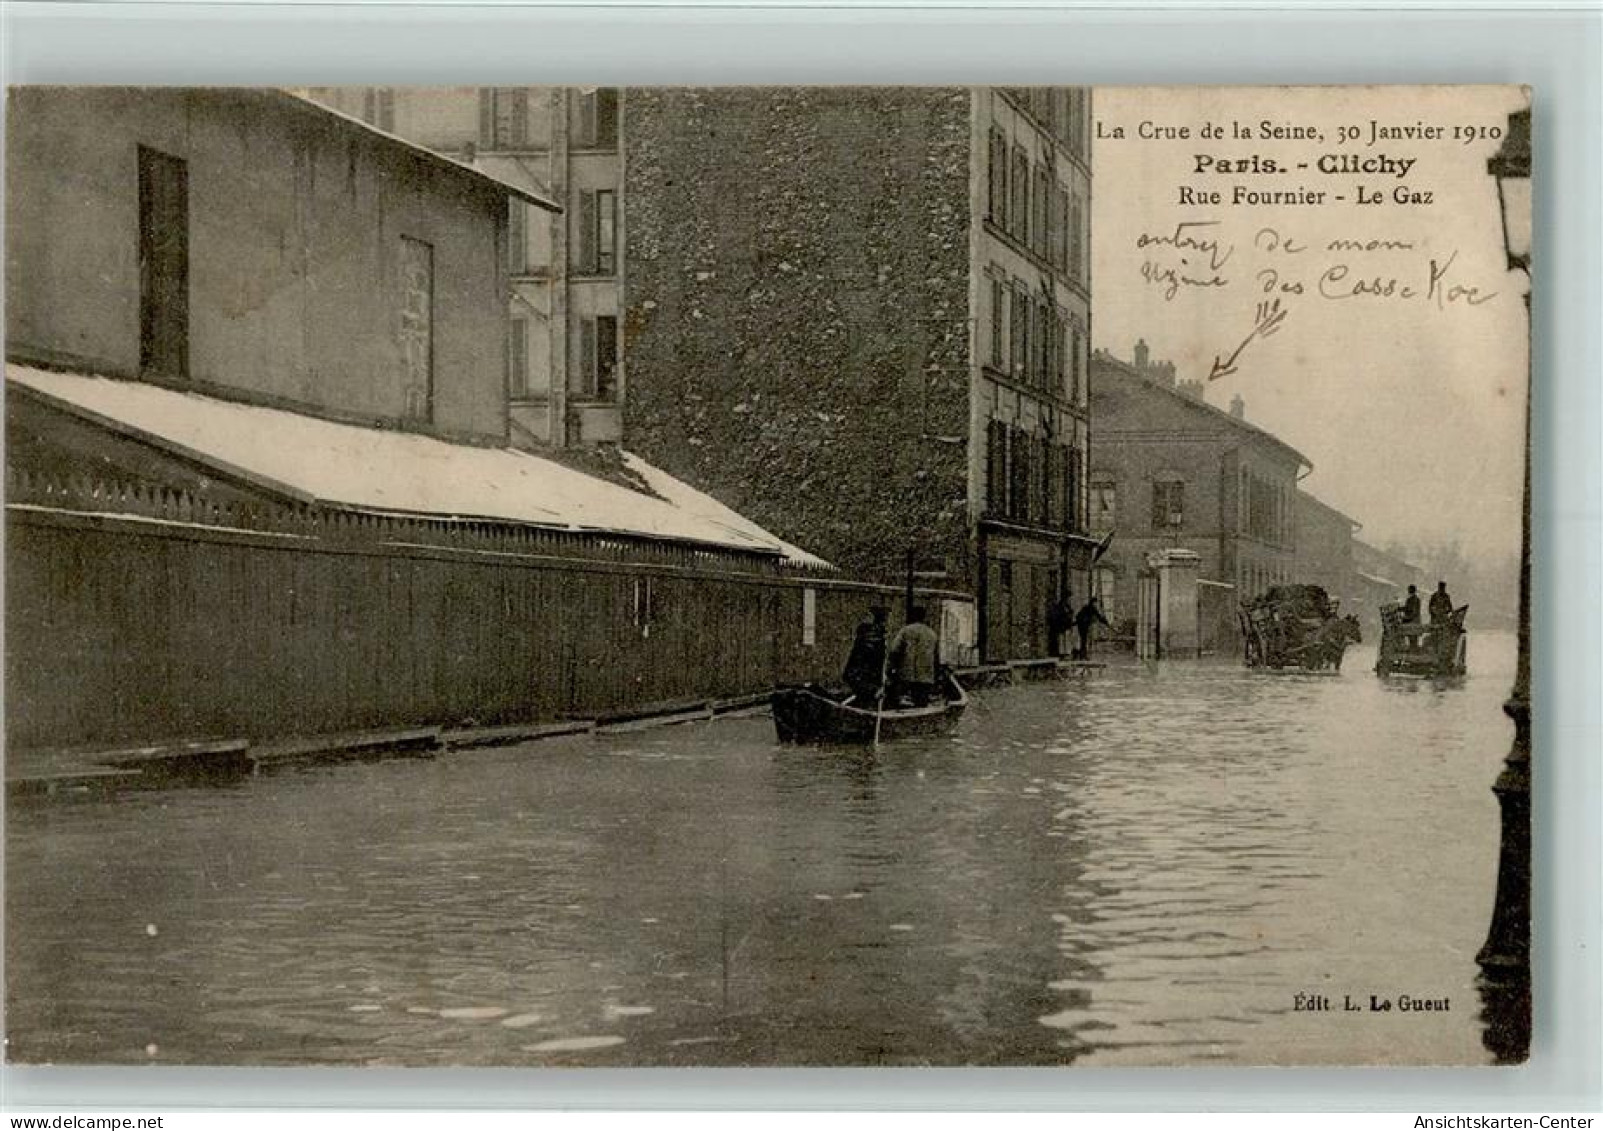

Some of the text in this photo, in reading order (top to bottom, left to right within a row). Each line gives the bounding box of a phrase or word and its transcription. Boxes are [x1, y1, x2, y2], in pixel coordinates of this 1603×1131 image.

[1097, 120, 1501, 146] La Crue de la Seine, 30 Janvier 1910
[1193, 155, 1287, 175] Paris.
[1318, 155, 1417, 178] Clichy
[1179, 187, 1221, 205] Rue
[1233, 188, 1326, 205] Fournier
[1357, 188, 1383, 205] Le
[1393, 187, 1434, 205] Gaz
[1255, 228, 1306, 253] de
[1257, 269, 1304, 295] des
[1344, 995, 1361, 1011] L.
